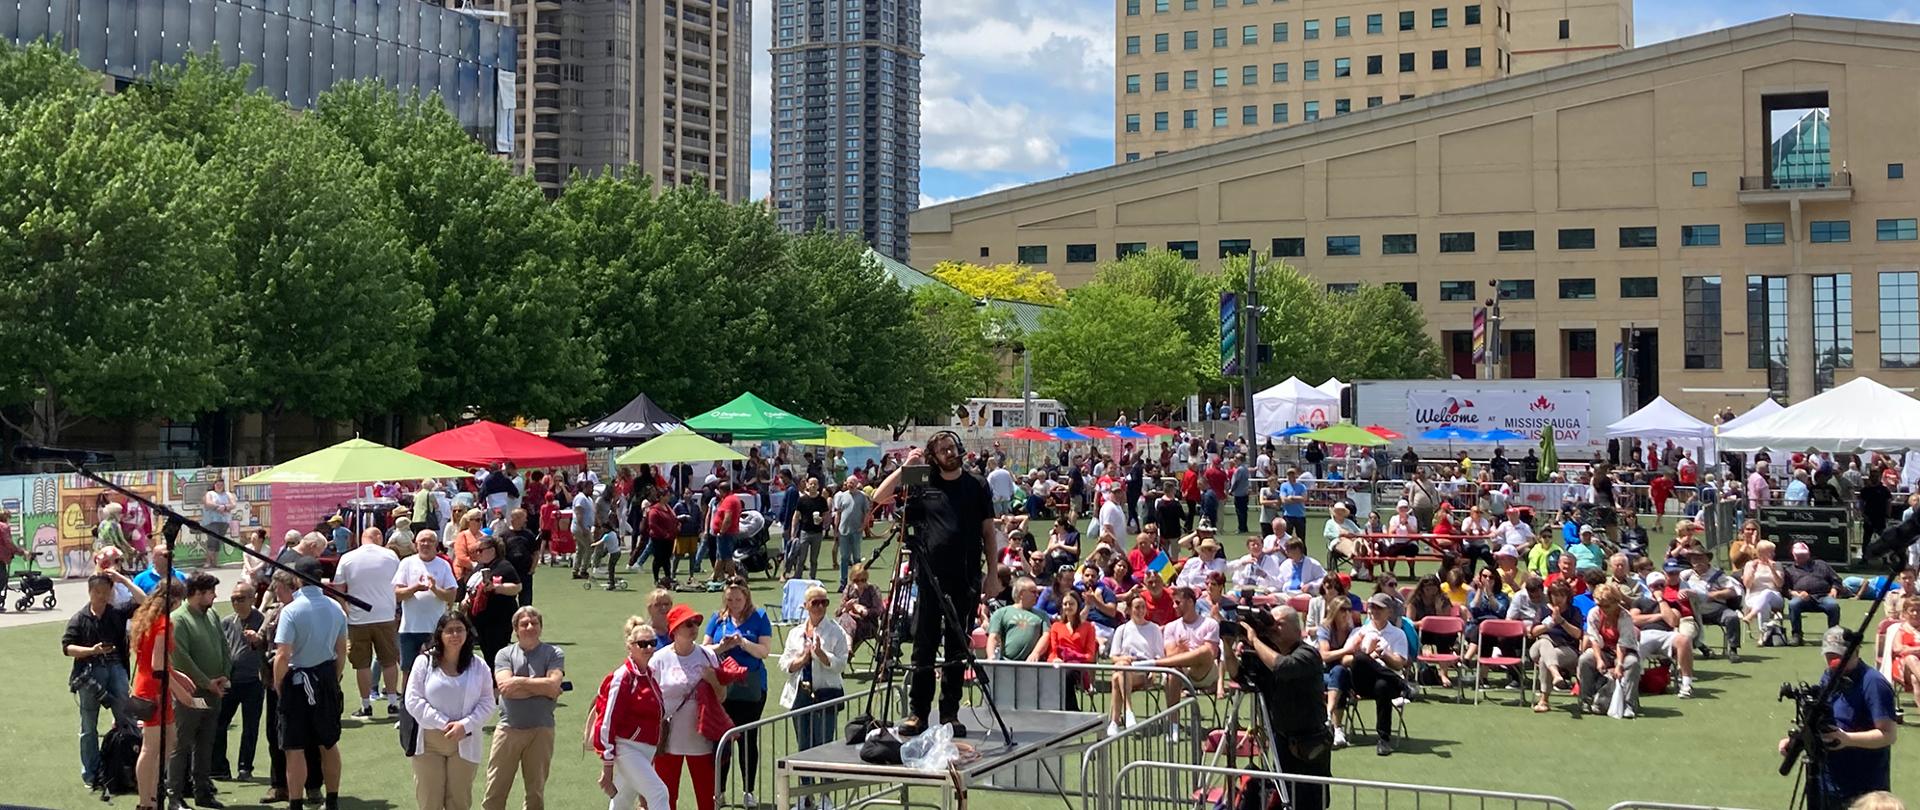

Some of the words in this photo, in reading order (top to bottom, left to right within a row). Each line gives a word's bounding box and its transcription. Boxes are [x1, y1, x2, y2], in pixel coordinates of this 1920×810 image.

[1416, 406, 1479, 423] Welcome
[588, 421, 645, 434] MNP
[1504, 418, 1580, 428] MISSISSAUGA
[1505, 429, 1543, 440] LIS
[1555, 429, 1580, 440] DAY
